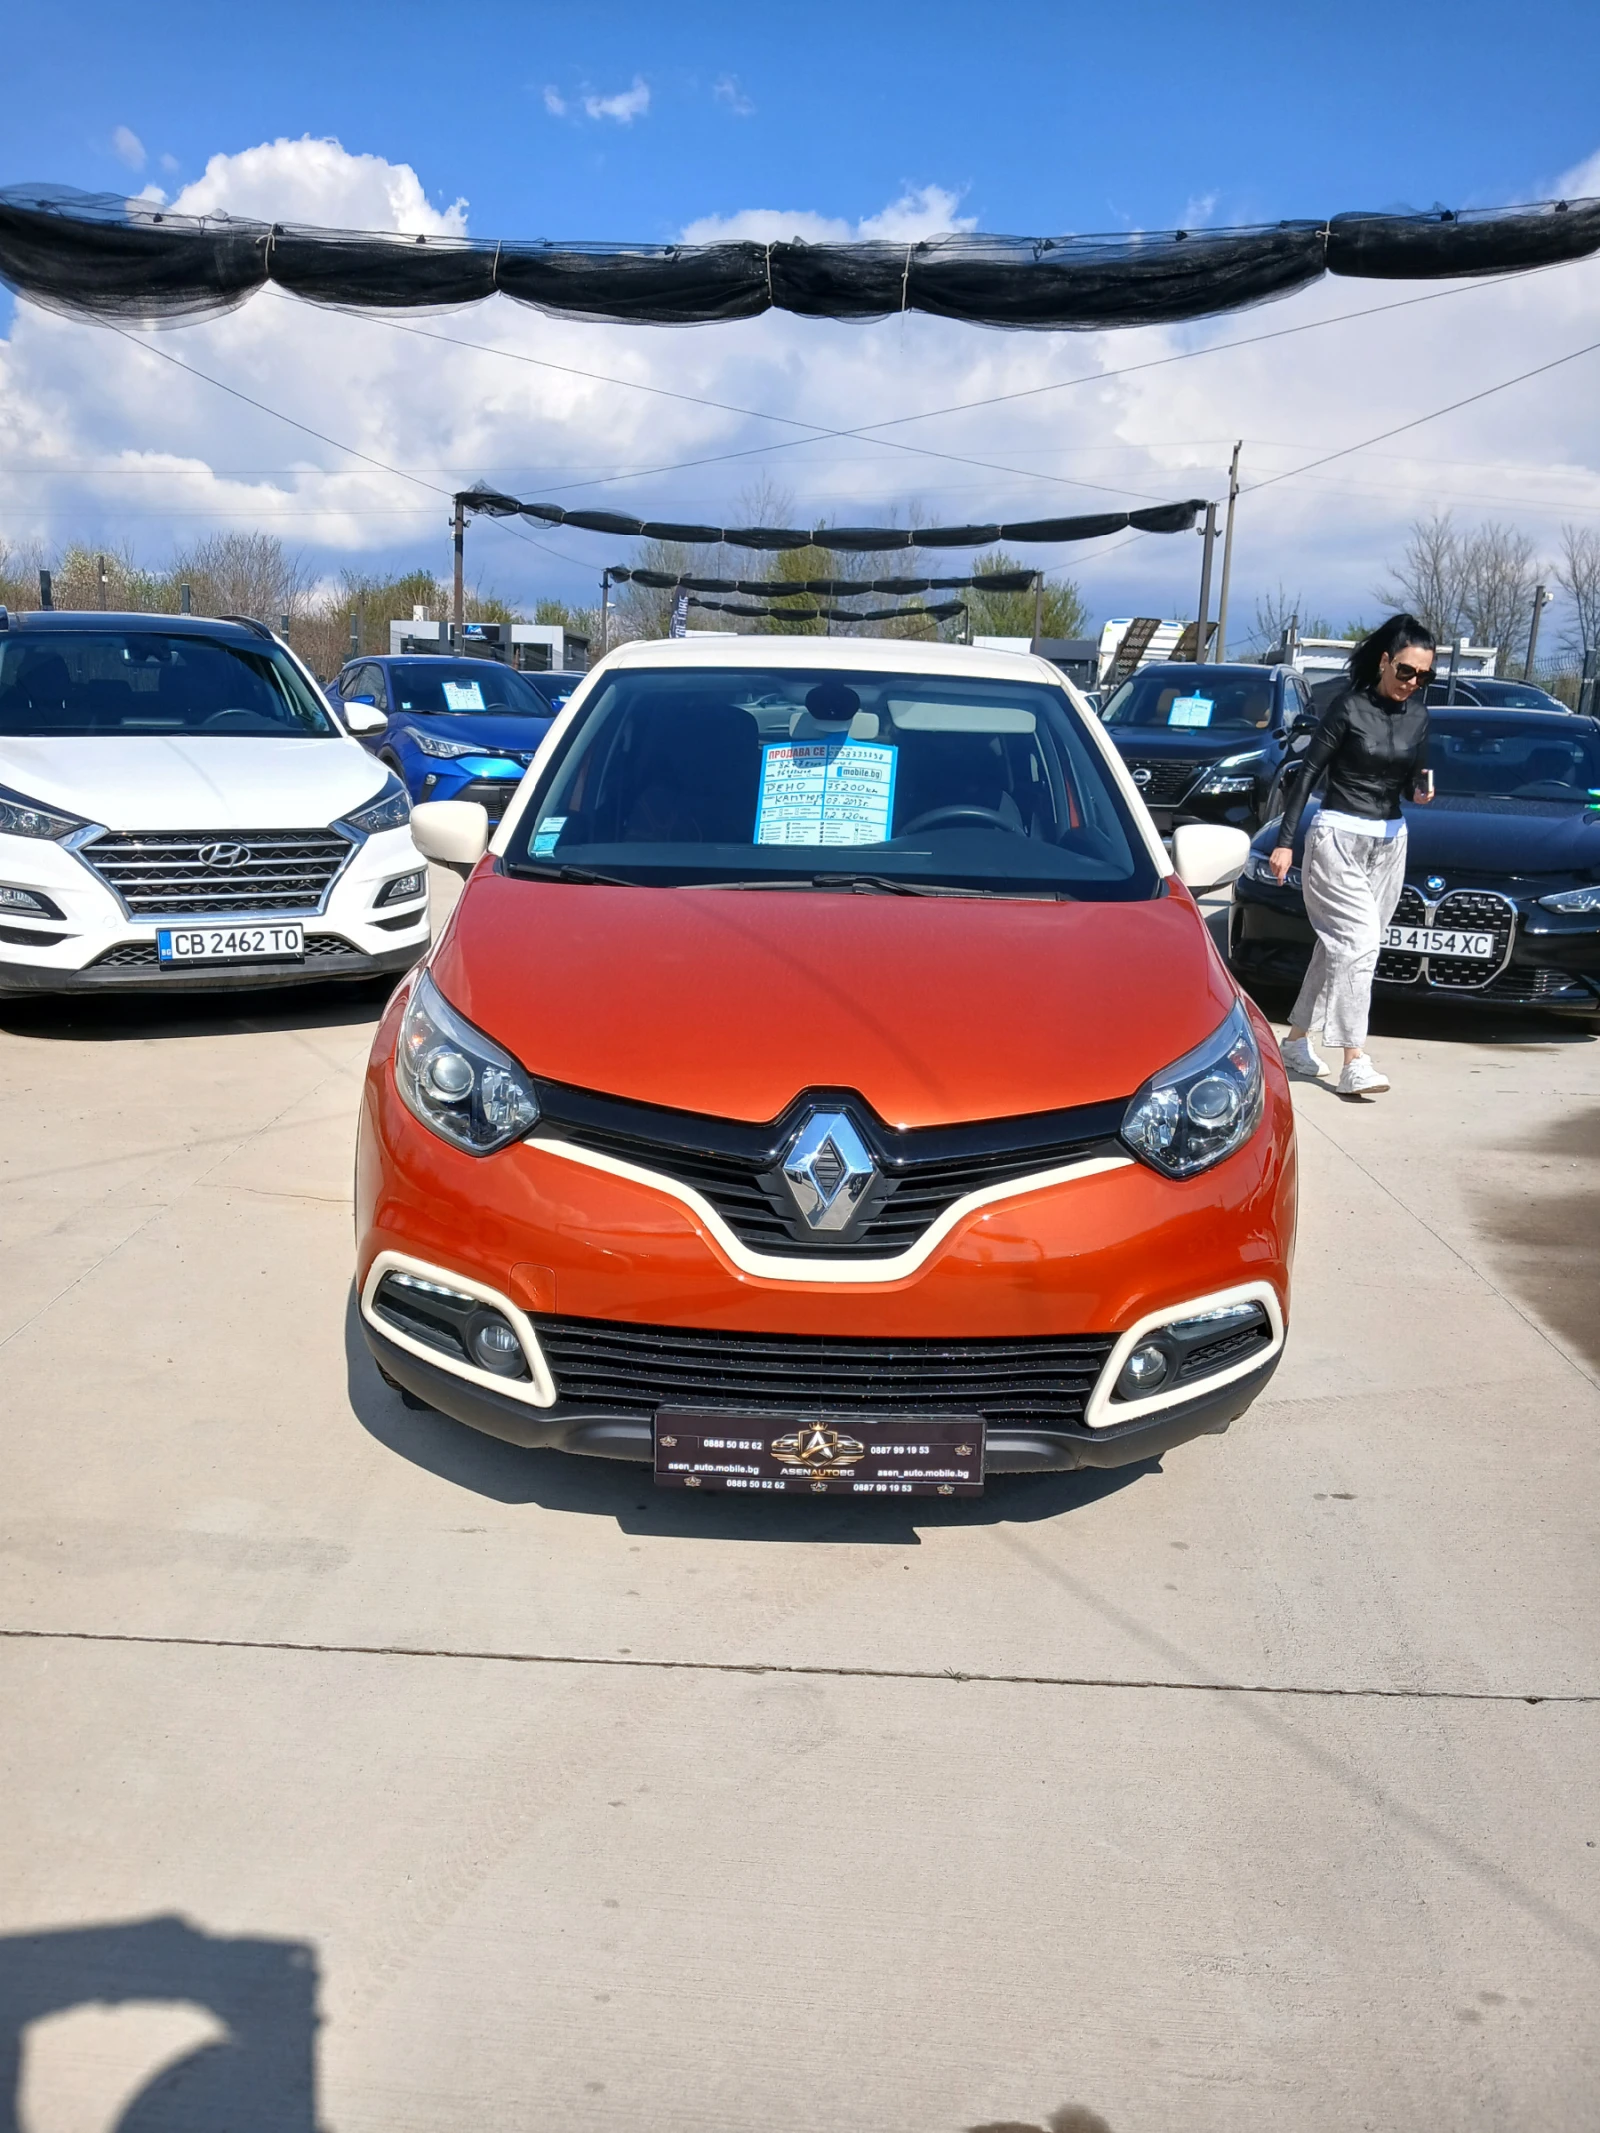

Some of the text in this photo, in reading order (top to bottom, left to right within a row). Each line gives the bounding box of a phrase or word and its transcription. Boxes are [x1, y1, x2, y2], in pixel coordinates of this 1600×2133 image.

[768, 746, 825, 760] ПРОДАВА СЕ
[843, 768, 880, 779] mobile.bg
[766, 782, 806, 794] РЕНО
[175, 934, 205, 955] CB
[210, 932, 265, 954] 2462
[270, 930, 299, 950] TO
[1406, 931, 1456, 952] 4154
[1460, 935, 1488, 954] XC
[704, 1439, 762, 1450] 0888 50 82 62
[870, 1446, 929, 1454] 0887 99 19 53
[668, 1462, 759, 1475] asen_auto.mobile.bg
[877, 1469, 969, 1479] asen_auto.mobile.bg
[727, 1479, 747, 1488] 0888
[749, 1480, 760, 1488] 50
[762, 1481, 772, 1489] 82
[876, 1484, 887, 1492] 99
[889, 1484, 900, 1492] 19
[902, 1484, 912, 1492] 53
